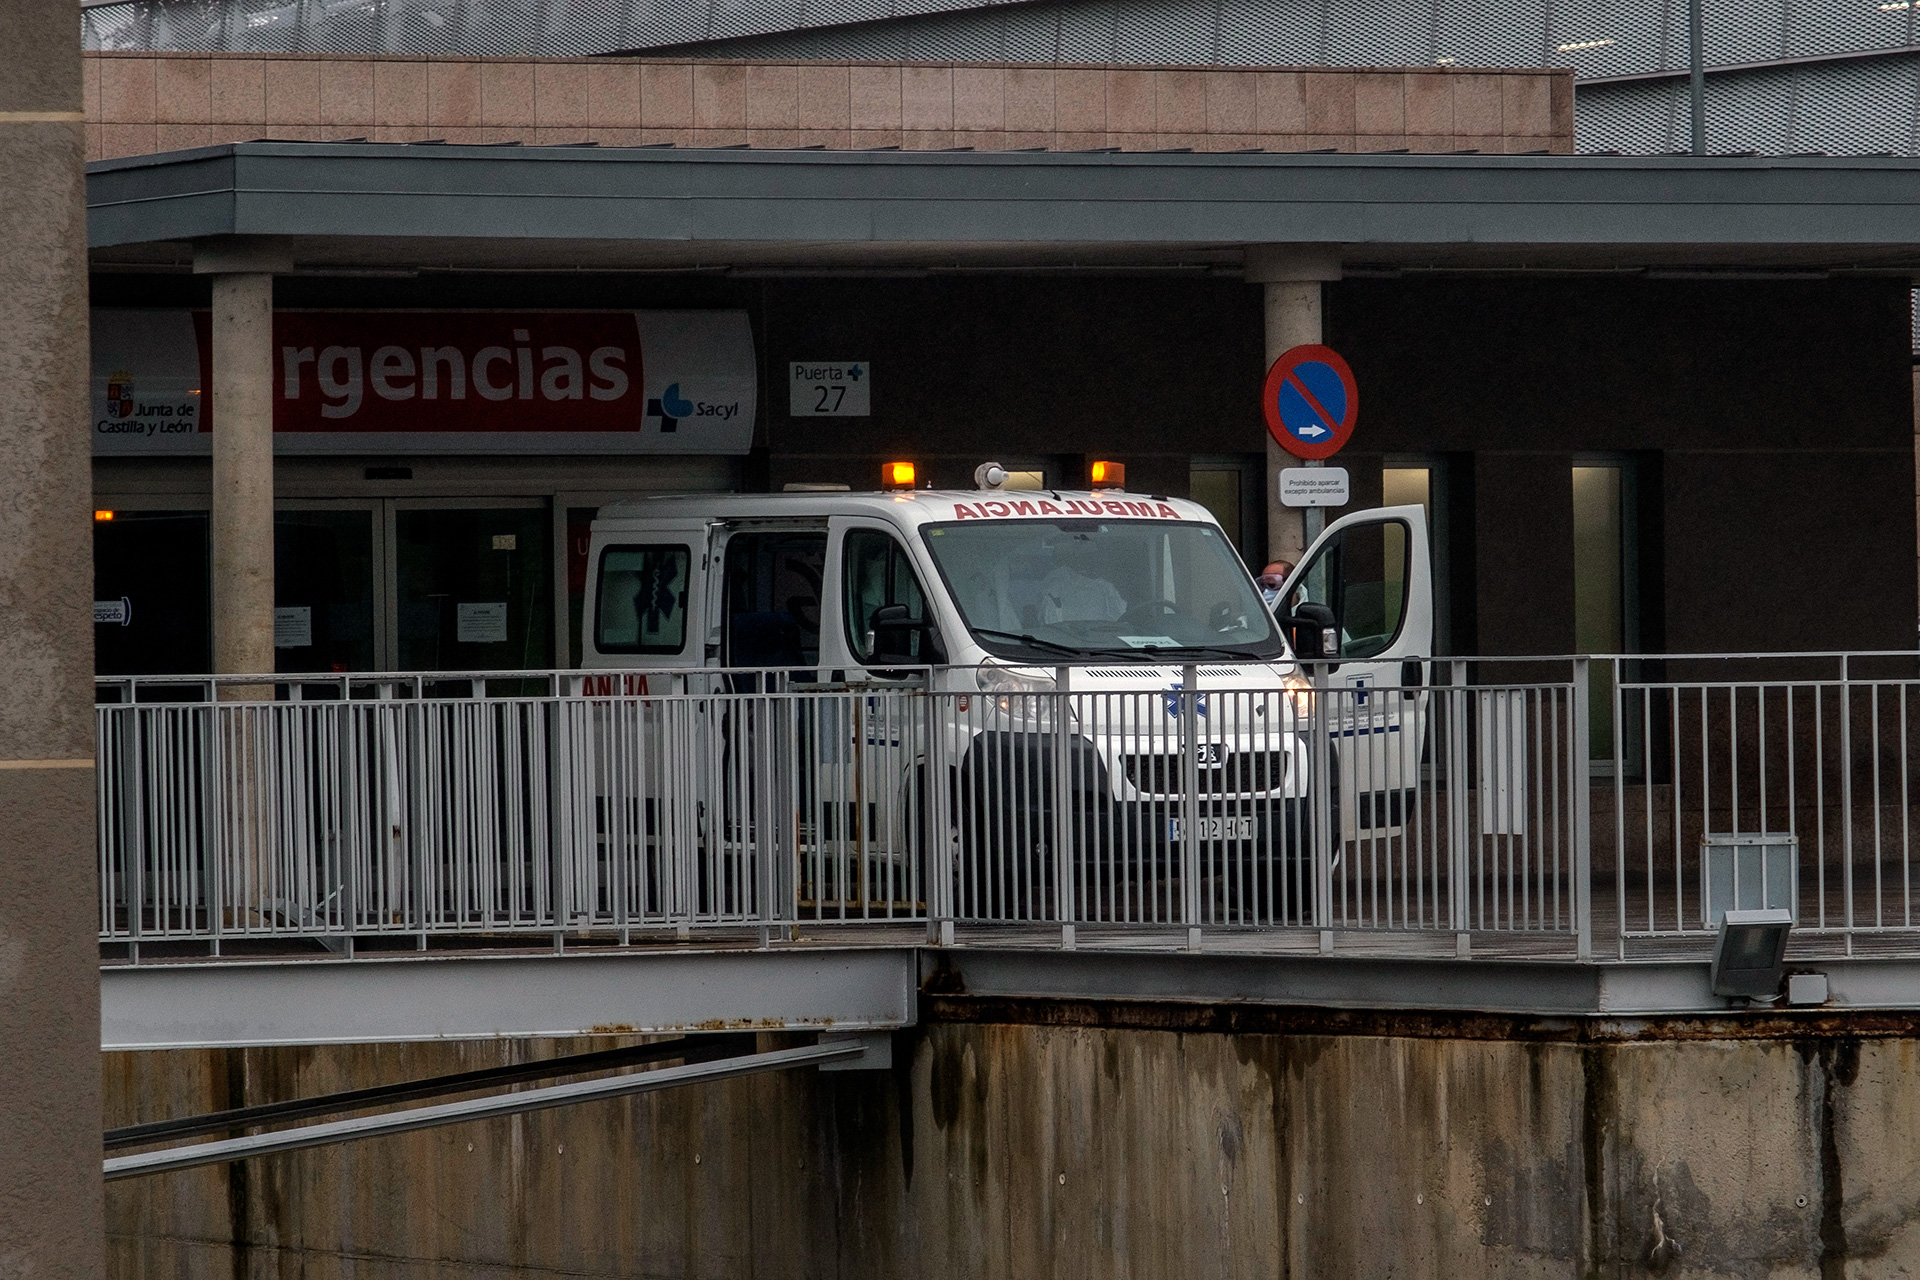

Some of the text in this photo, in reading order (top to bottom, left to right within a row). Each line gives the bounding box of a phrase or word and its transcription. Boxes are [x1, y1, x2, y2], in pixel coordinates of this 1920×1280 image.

[281, 328, 630, 419] rgencias
[796, 365, 843, 380] Puerta
[814, 385, 846, 412] 27
[135, 403, 194, 416] Junta de
[696, 401, 739, 419] Sacyl
[98, 419, 193, 436] Castilla y León
[577, 537, 589, 556] U
[94, 612, 122, 621] espeto
[583, 674, 651, 707] ANIA
